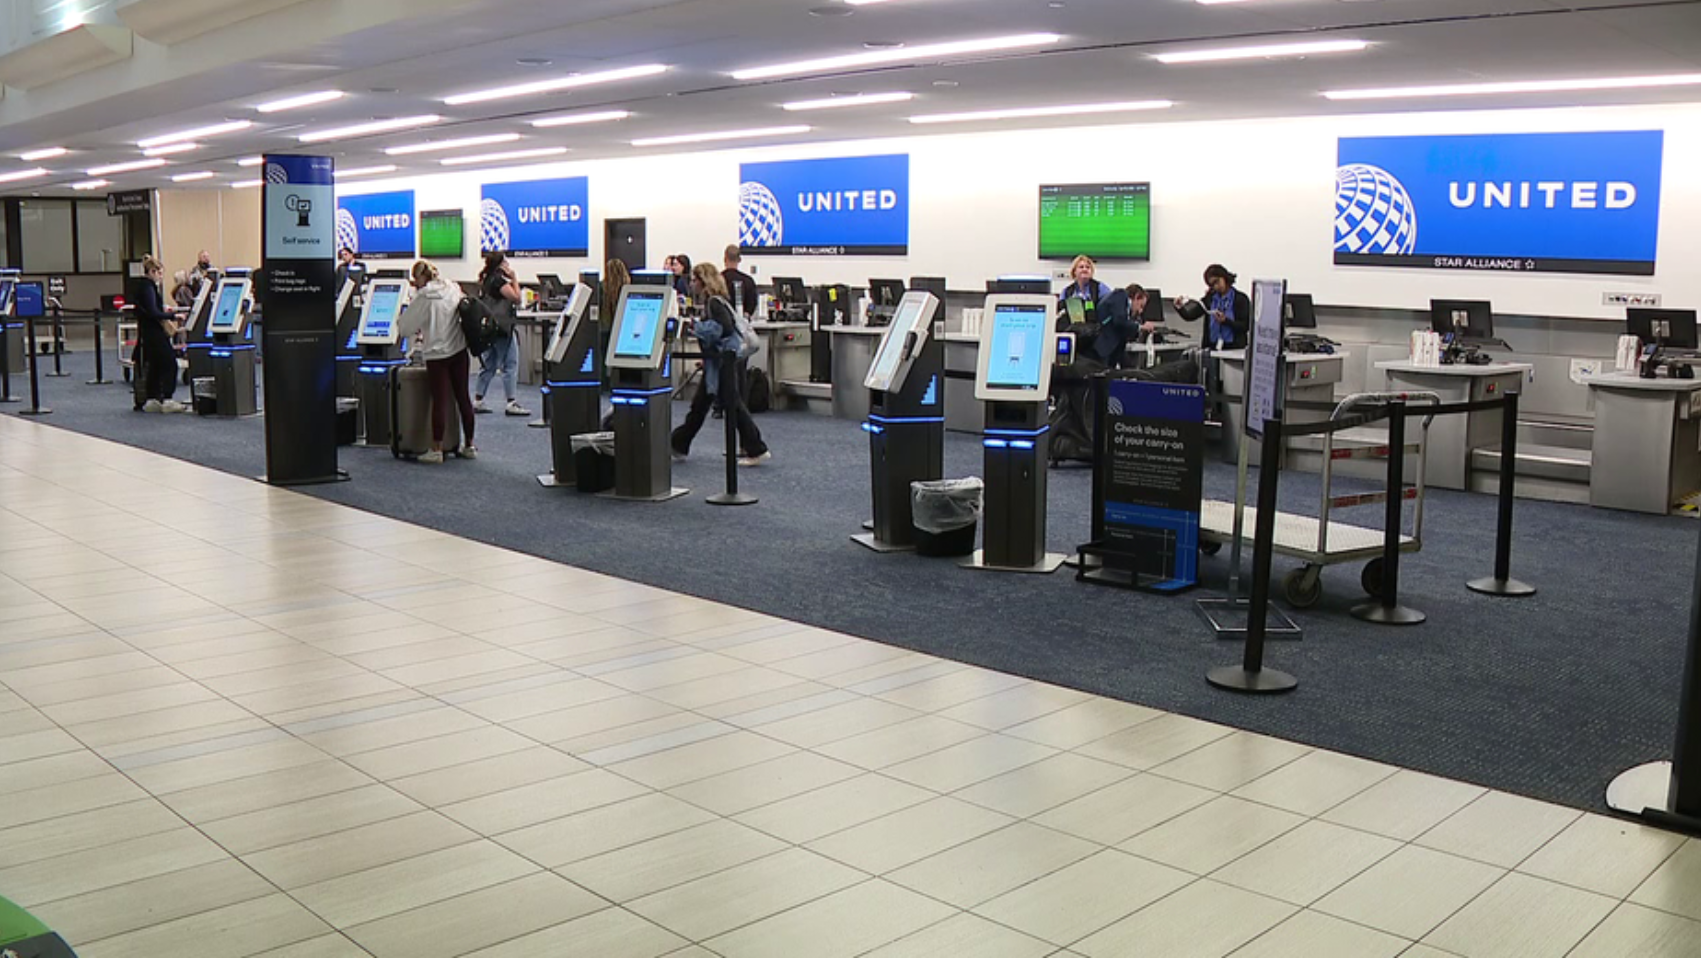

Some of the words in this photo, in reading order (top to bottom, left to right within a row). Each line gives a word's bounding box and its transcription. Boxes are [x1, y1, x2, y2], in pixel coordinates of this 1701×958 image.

[798, 190, 897, 211] UNITED
[1449, 181, 1637, 209] UNITED
[518, 205, 581, 222] UNITED
[364, 214, 410, 229] UNITED
[282, 236, 296, 245] Self
[297, 237, 320, 245] service
[792, 246, 807, 254] STAR
[808, 246, 838, 254] ALLIANCE
[1434, 257, 1462, 267] STAR
[1464, 258, 1521, 269] ALLIANCE
[1163, 387, 1199, 397] UNITED
[1114, 422, 1143, 435] Check
[1143, 425, 1160, 436] the
[1160, 426, 1179, 438] size
[1114, 434, 1124, 444] of
[1125, 437, 1145, 448] your
[1145, 438, 1184, 451] carry-on
